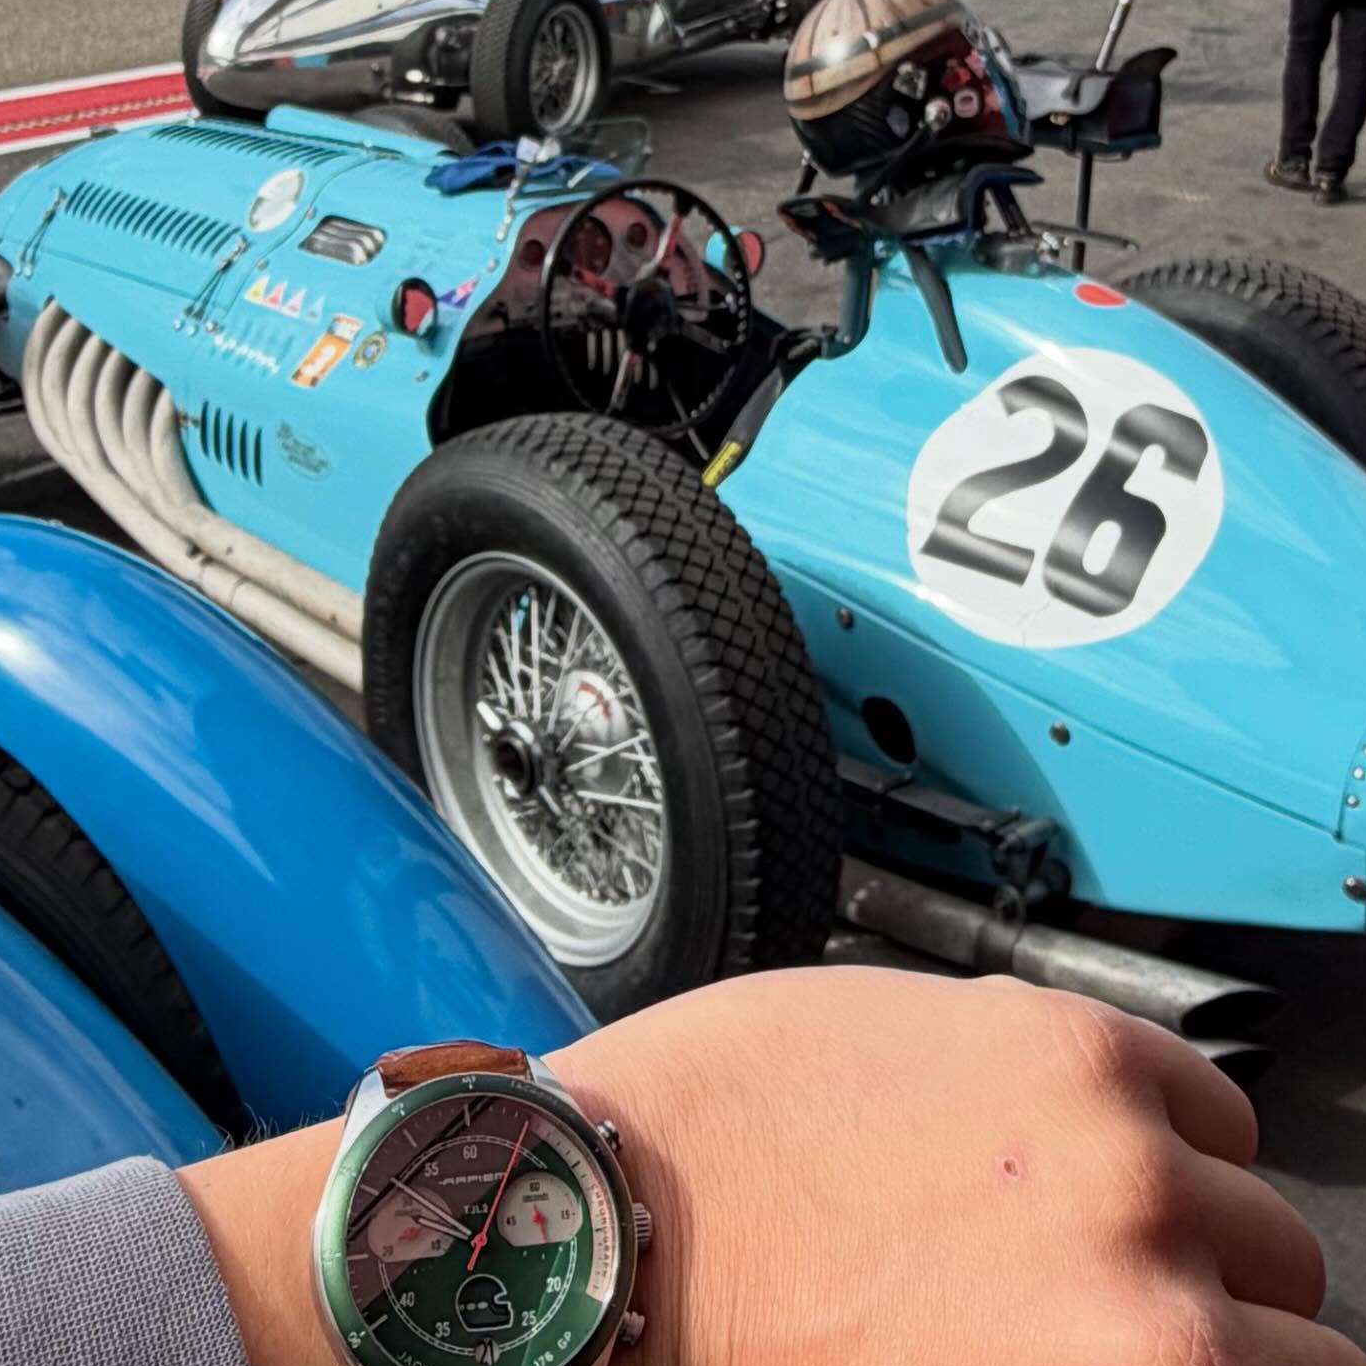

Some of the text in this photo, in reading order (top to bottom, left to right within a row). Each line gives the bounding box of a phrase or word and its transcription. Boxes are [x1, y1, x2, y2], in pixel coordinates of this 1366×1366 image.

[920, 375, 1208, 617] 26
[463, 1145, 478, 1160] 60
[424, 1162, 440, 1178] 55
[546, 1276, 562, 1293] 20
[399, 1291, 416, 1308] 40
[521, 1310, 537, 1327] 25
[434, 1322, 451, 1339] 35
[557, 1330, 573, 1351] GP
